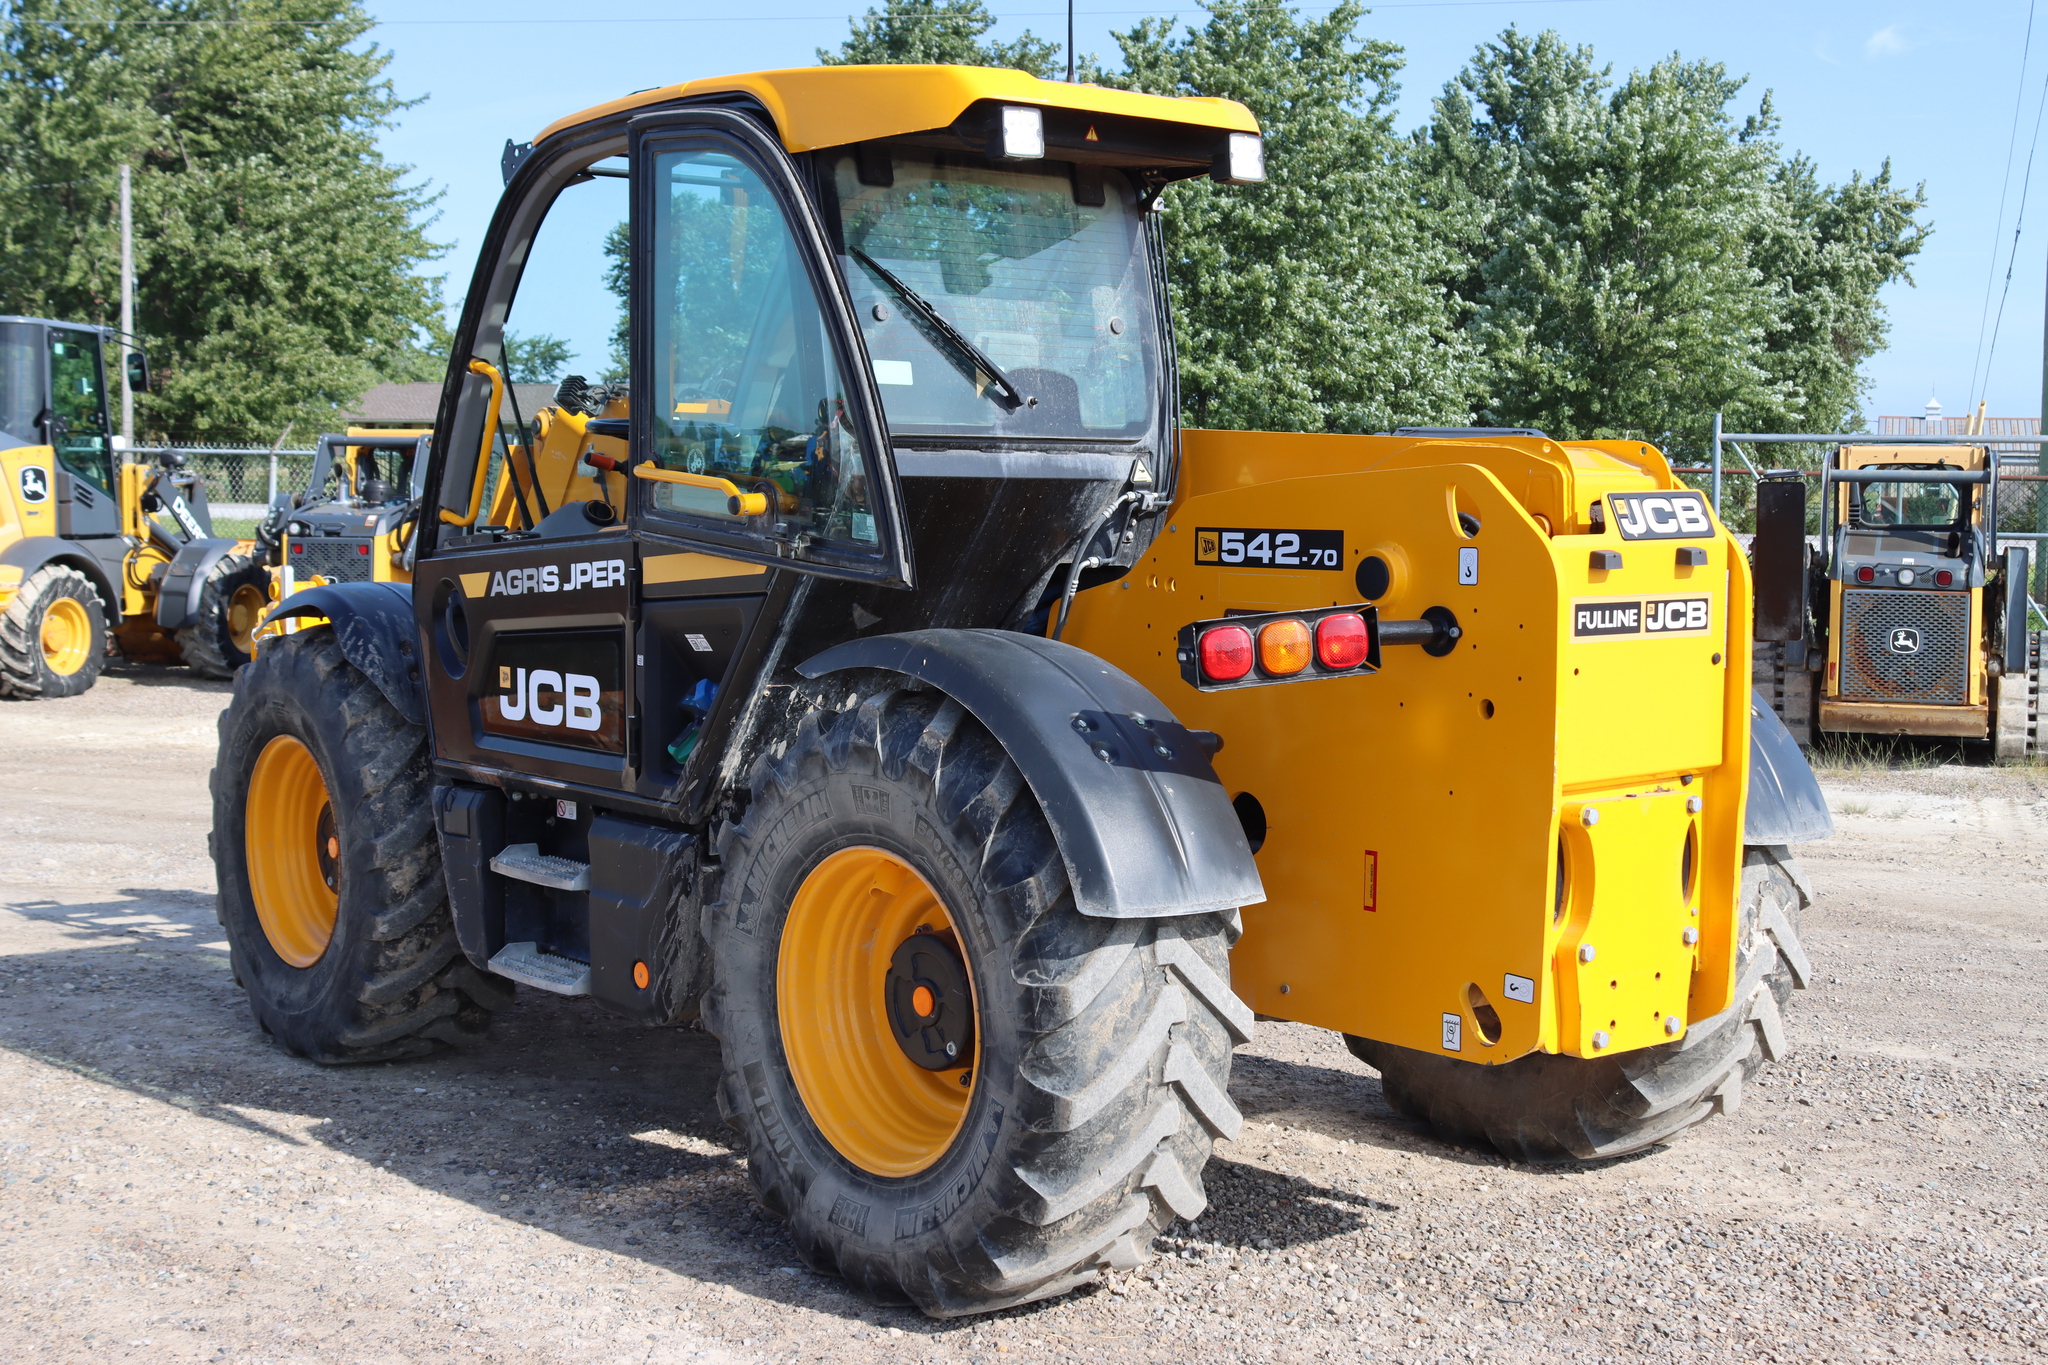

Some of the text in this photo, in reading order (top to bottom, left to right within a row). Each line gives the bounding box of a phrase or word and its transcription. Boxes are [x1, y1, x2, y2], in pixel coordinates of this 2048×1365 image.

[172, 496, 208, 539] DEER
[1618, 498, 1709, 536] JCB
[1577, 609, 1638, 629] FULLINE
[1646, 601, 1707, 630] JCB
[500, 667, 601, 732] JCB
[746, 789, 828, 900] MICHELIN
[754, 1086, 803, 1172] XMCL
[896, 1135, 991, 1237] MICHELIN
